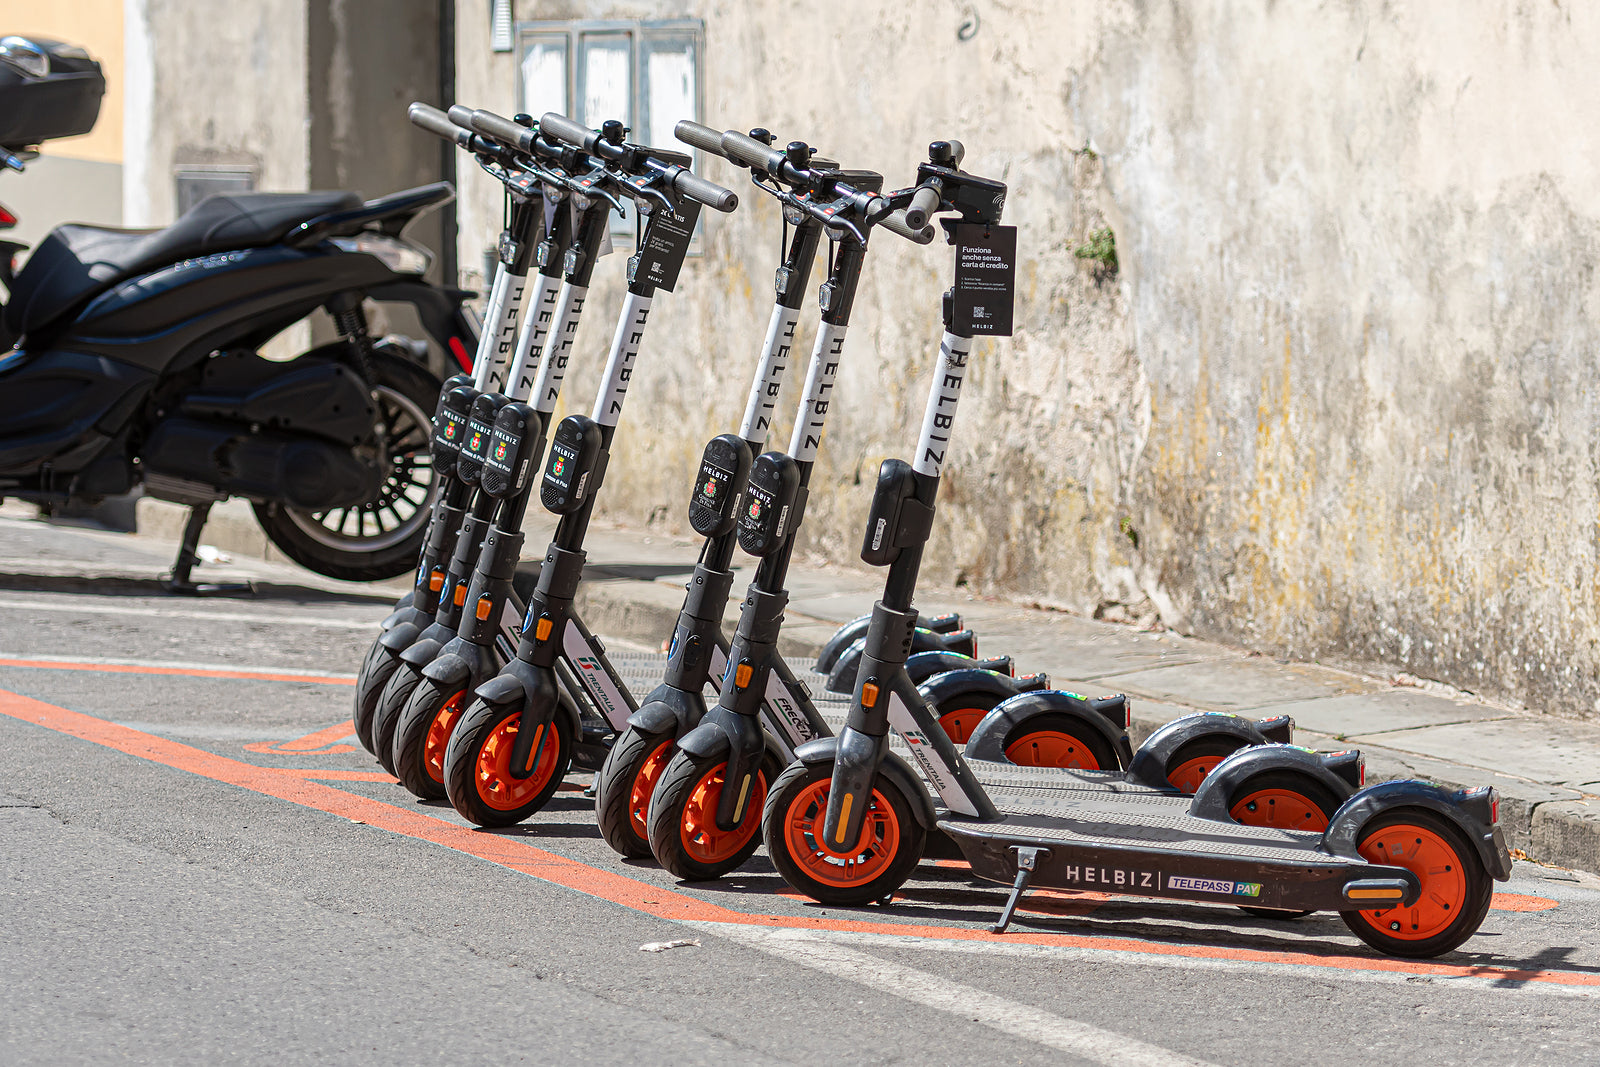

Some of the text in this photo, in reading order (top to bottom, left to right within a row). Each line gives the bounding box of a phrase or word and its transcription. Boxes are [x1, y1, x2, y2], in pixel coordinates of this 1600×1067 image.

[490, 287, 524, 384] HELBIZ
[520, 288, 558, 389] HELBIZ
[548, 298, 585, 400] HELBIZ
[610, 308, 649, 414] HELBIZ
[756, 320, 797, 430] HELBIZ
[804, 338, 844, 449] HELBIZ
[924, 348, 968, 464] HELBIZ
[443, 410, 466, 425] HELBIZ
[470, 421, 491, 435] HELBIZ
[495, 430, 517, 445] HELBIZ
[554, 444, 575, 459] HELBIZ
[703, 466, 728, 482] HELBIZ
[749, 486, 771, 504] HELBIZ
[586, 672, 616, 712] TRENITALIA
[916, 748, 946, 791] TRENITALIA
[992, 797, 1081, 808] ELBIZ
[1066, 865, 1258, 896] HELBIZ TELEPASS PAY
